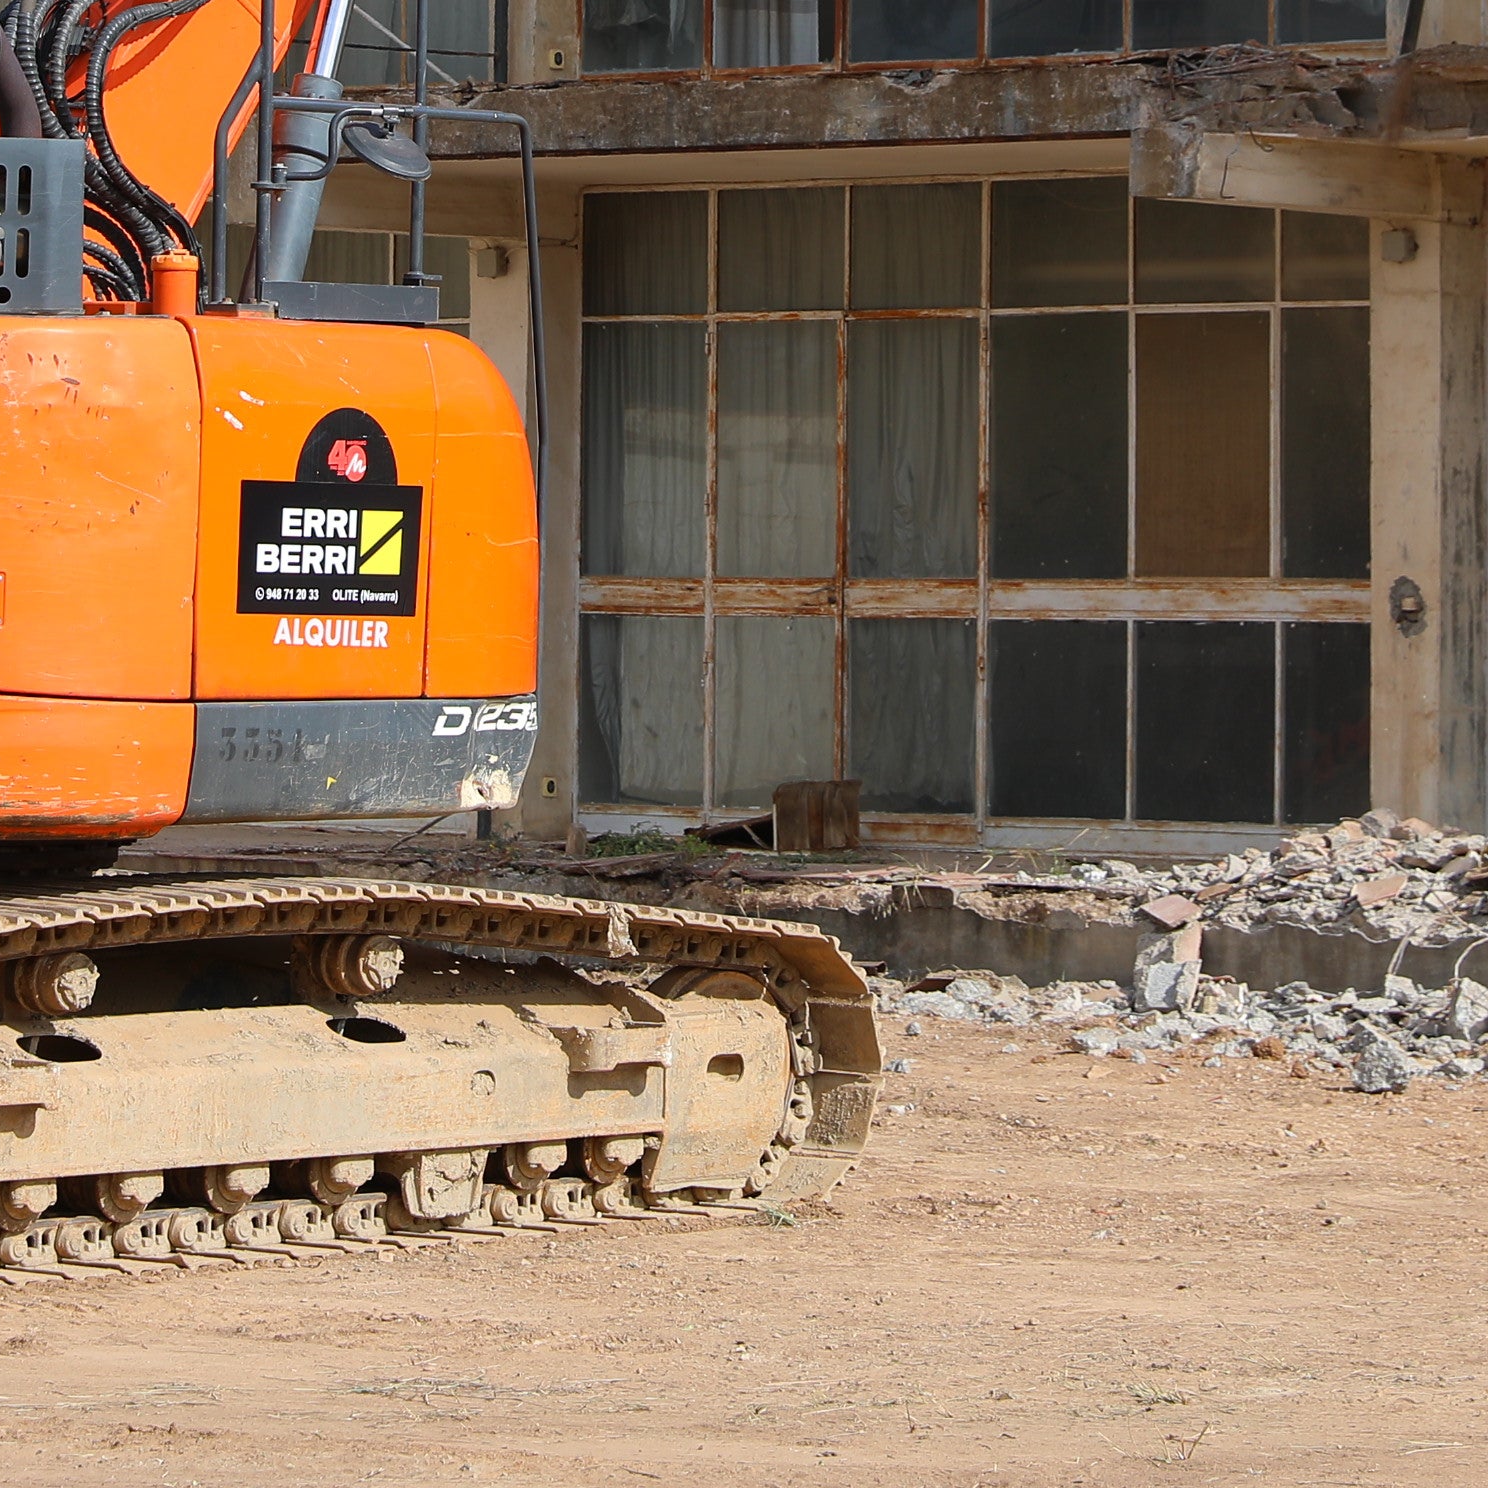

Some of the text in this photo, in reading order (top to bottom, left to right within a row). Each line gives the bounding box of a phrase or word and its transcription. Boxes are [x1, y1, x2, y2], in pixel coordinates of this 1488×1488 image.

[281, 508, 358, 538] ERRI
[256, 543, 356, 575] BERRI
[266, 588, 399, 604] 948 71 20 33 OLITE (Navarra)
[273, 618, 389, 648] ALQUILER
